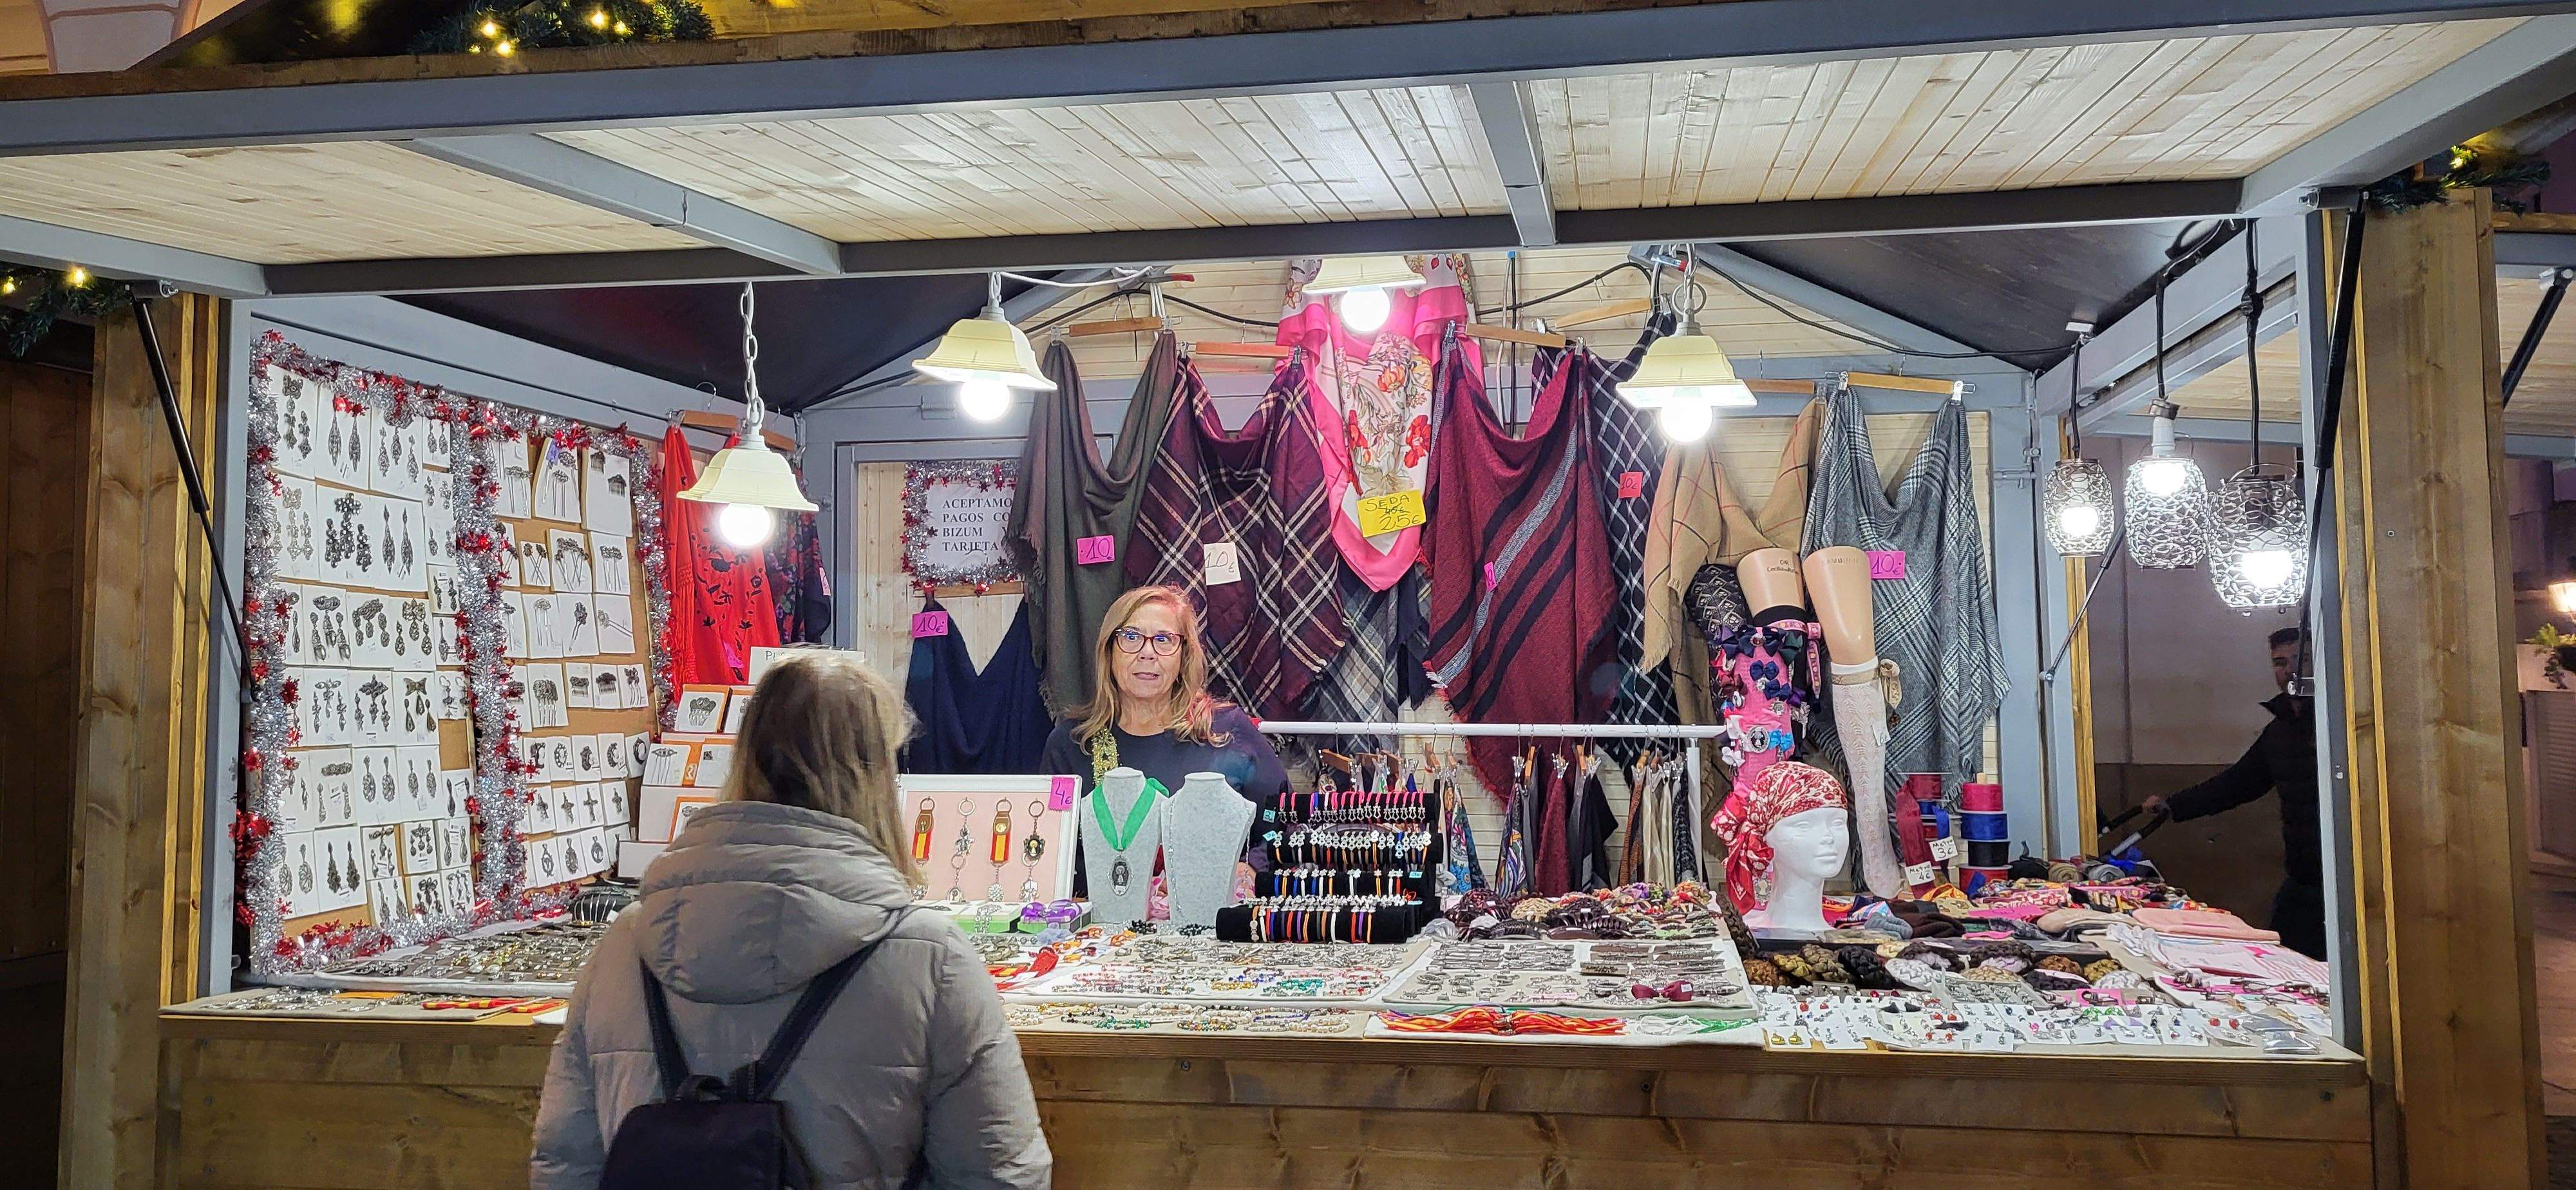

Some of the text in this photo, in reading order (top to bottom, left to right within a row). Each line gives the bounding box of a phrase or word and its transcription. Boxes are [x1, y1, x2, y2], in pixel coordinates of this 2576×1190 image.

[1365, 494, 1409, 512] SEDA
[943, 513, 983, 522] PAGOS
[1379, 514, 1421, 530] 25€
[943, 527, 982, 536] BIZUM
[942, 542, 998, 551] TARJETA
[1056, 781, 1072, 805] 4€
[1910, 865, 1929, 873] Metro
